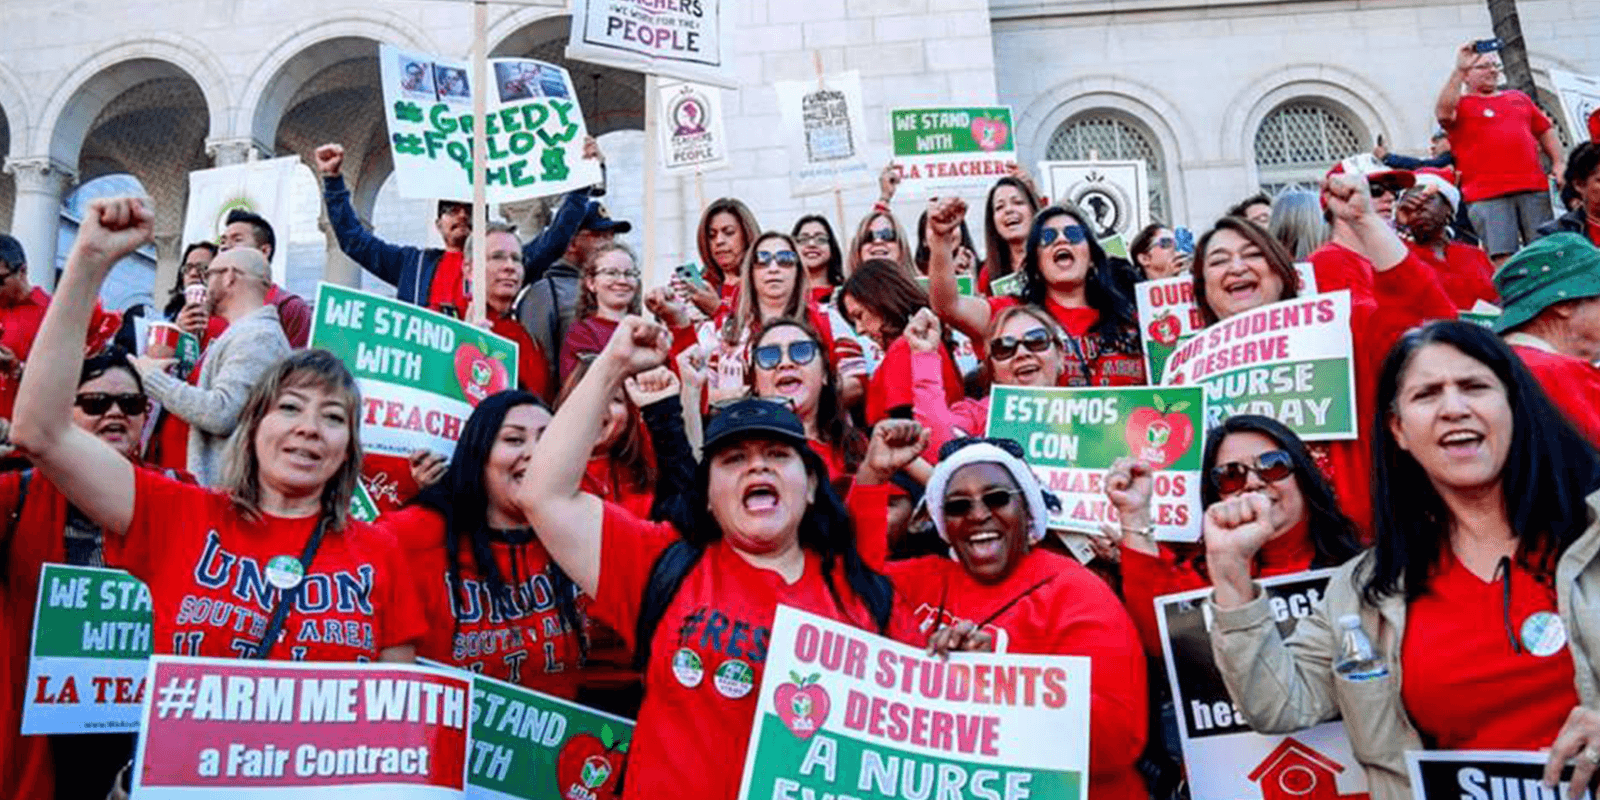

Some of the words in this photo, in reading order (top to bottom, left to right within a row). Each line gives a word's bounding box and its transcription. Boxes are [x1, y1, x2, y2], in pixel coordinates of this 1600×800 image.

[606, 15, 700, 52] PEOPLE
[896, 114, 917, 131] WE
[921, 112, 970, 130] STAND
[916, 133, 953, 152] WITH
[1149, 281, 1195, 308] OUR
[324, 295, 367, 330] WE
[373, 306, 456, 354] STAND
[1170, 335, 1205, 374] OUR
[1207, 299, 1336, 350] STUDENTS
[355, 341, 422, 382] WITH
[1190, 334, 1290, 382] DESERVE
[1206, 362, 1314, 402] NURSE
[1003, 394, 1120, 425] ESTAMOS
[1027, 430, 1080, 462] CON
[1049, 470, 1187, 498] MAEOS
[1070, 500, 1190, 527] ANGES
[49, 576, 93, 609] WE
[82, 620, 152, 652] WITH
[793, 622, 869, 680] OUR
[875, 649, 1068, 709] STUDENTS
[33, 674, 81, 705] LA
[157, 675, 294, 722] #ARM
[300, 678, 360, 723] ME
[364, 679, 466, 729] WITH
[843, 688, 1001, 757] DESERVE
[198, 748, 220, 777] a
[226, 744, 290, 777] Fair
[294, 744, 430, 777] Contract
[798, 734, 838, 783] A
[858, 749, 1033, 800] NURSE
